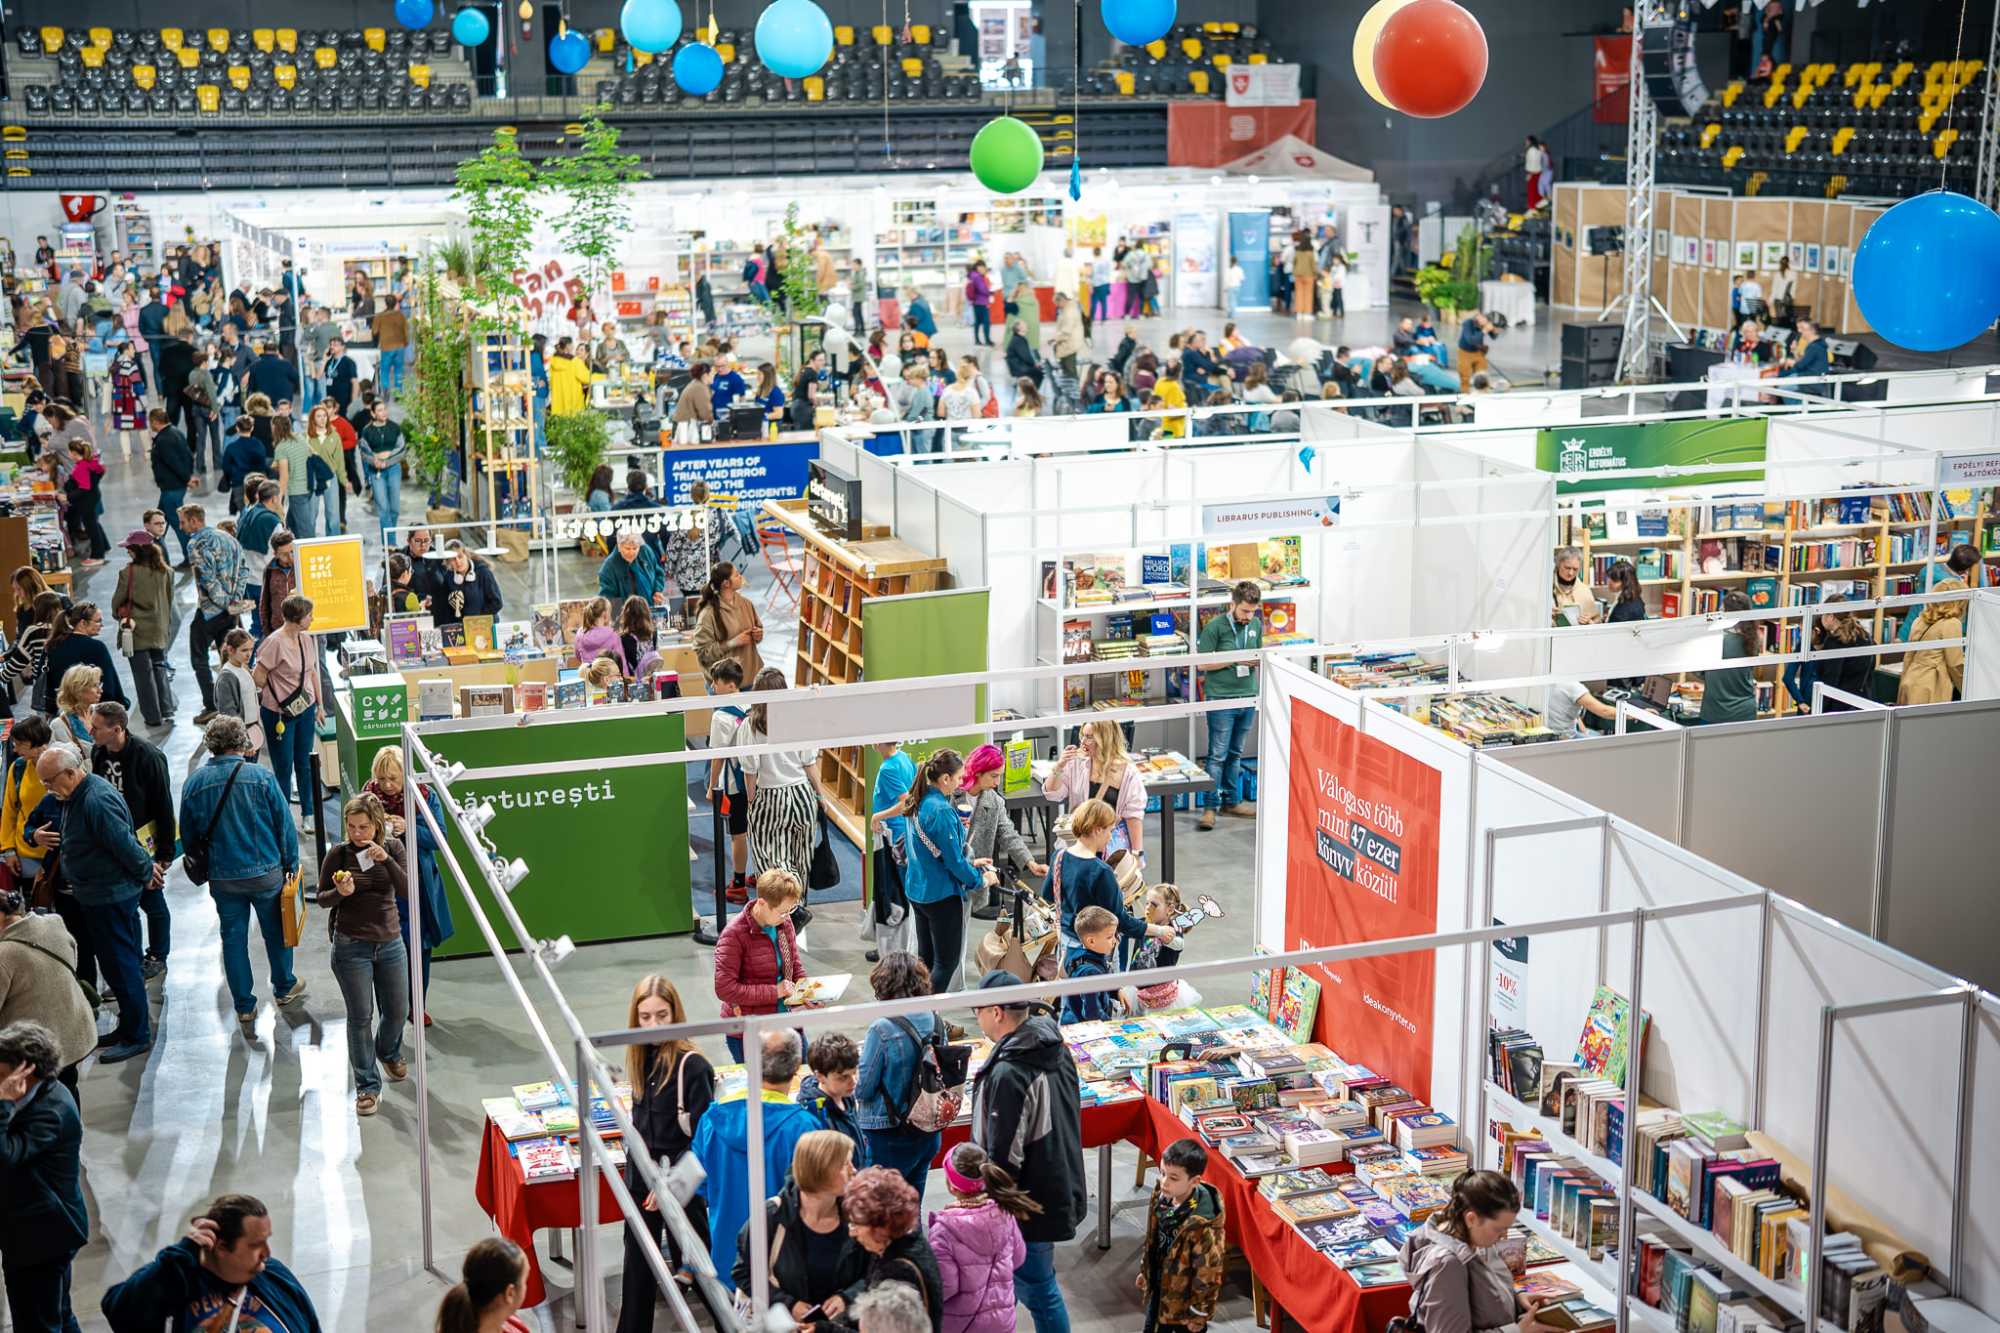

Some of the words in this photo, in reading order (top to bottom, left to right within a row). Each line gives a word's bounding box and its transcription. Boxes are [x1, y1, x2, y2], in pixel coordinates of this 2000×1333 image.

[672, 460, 707, 471] AFTER
[708, 458, 744, 469] YEARS
[745, 456, 761, 467] OF
[672, 471, 704, 482] TRIAL
[705, 469, 729, 480] AND
[730, 467, 767, 478] ERROR
[723, 479, 745, 490] THE
[1217, 513, 1259, 523] LIBRARUS
[1260, 508, 1313, 520] PUBLISHING
[453, 779, 616, 812] ărturești
[1317, 768, 1372, 821] Válogass
[1374, 802, 1404, 838] több
[1318, 807, 1350, 840] mint
[1350, 823, 1367, 850] 47
[1367, 836, 1400, 870] ezer
[1316, 830, 1354, 878] könyv
[1356, 857, 1398, 905] közül!
